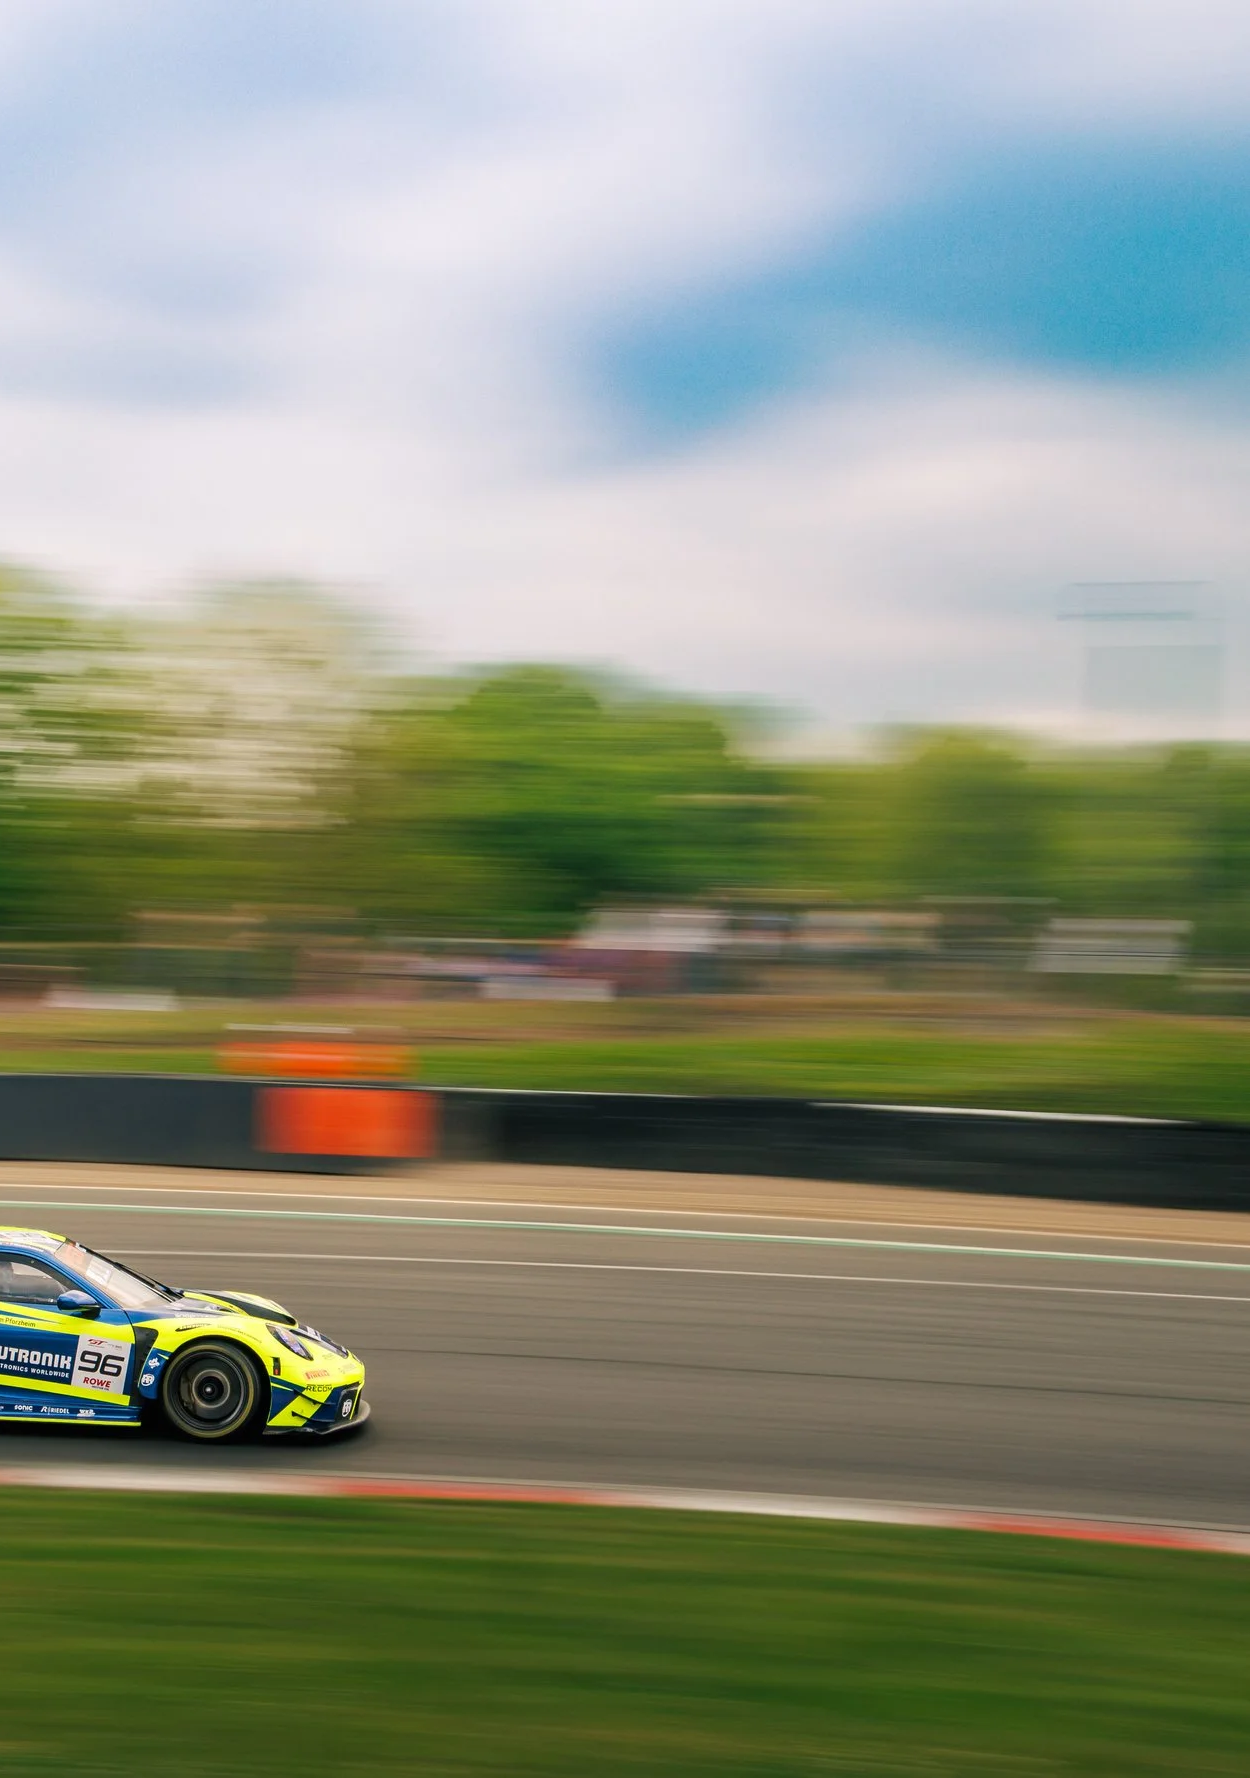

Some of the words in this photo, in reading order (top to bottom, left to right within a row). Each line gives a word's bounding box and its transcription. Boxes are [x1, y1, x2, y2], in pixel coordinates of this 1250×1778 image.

[5, 1317, 36, 1328] Pforzheim
[78, 1350, 125, 1377] 96
[30, 1367, 70, 1379] WORLDWIDE
[83, 1376, 112, 1388] ROWE
